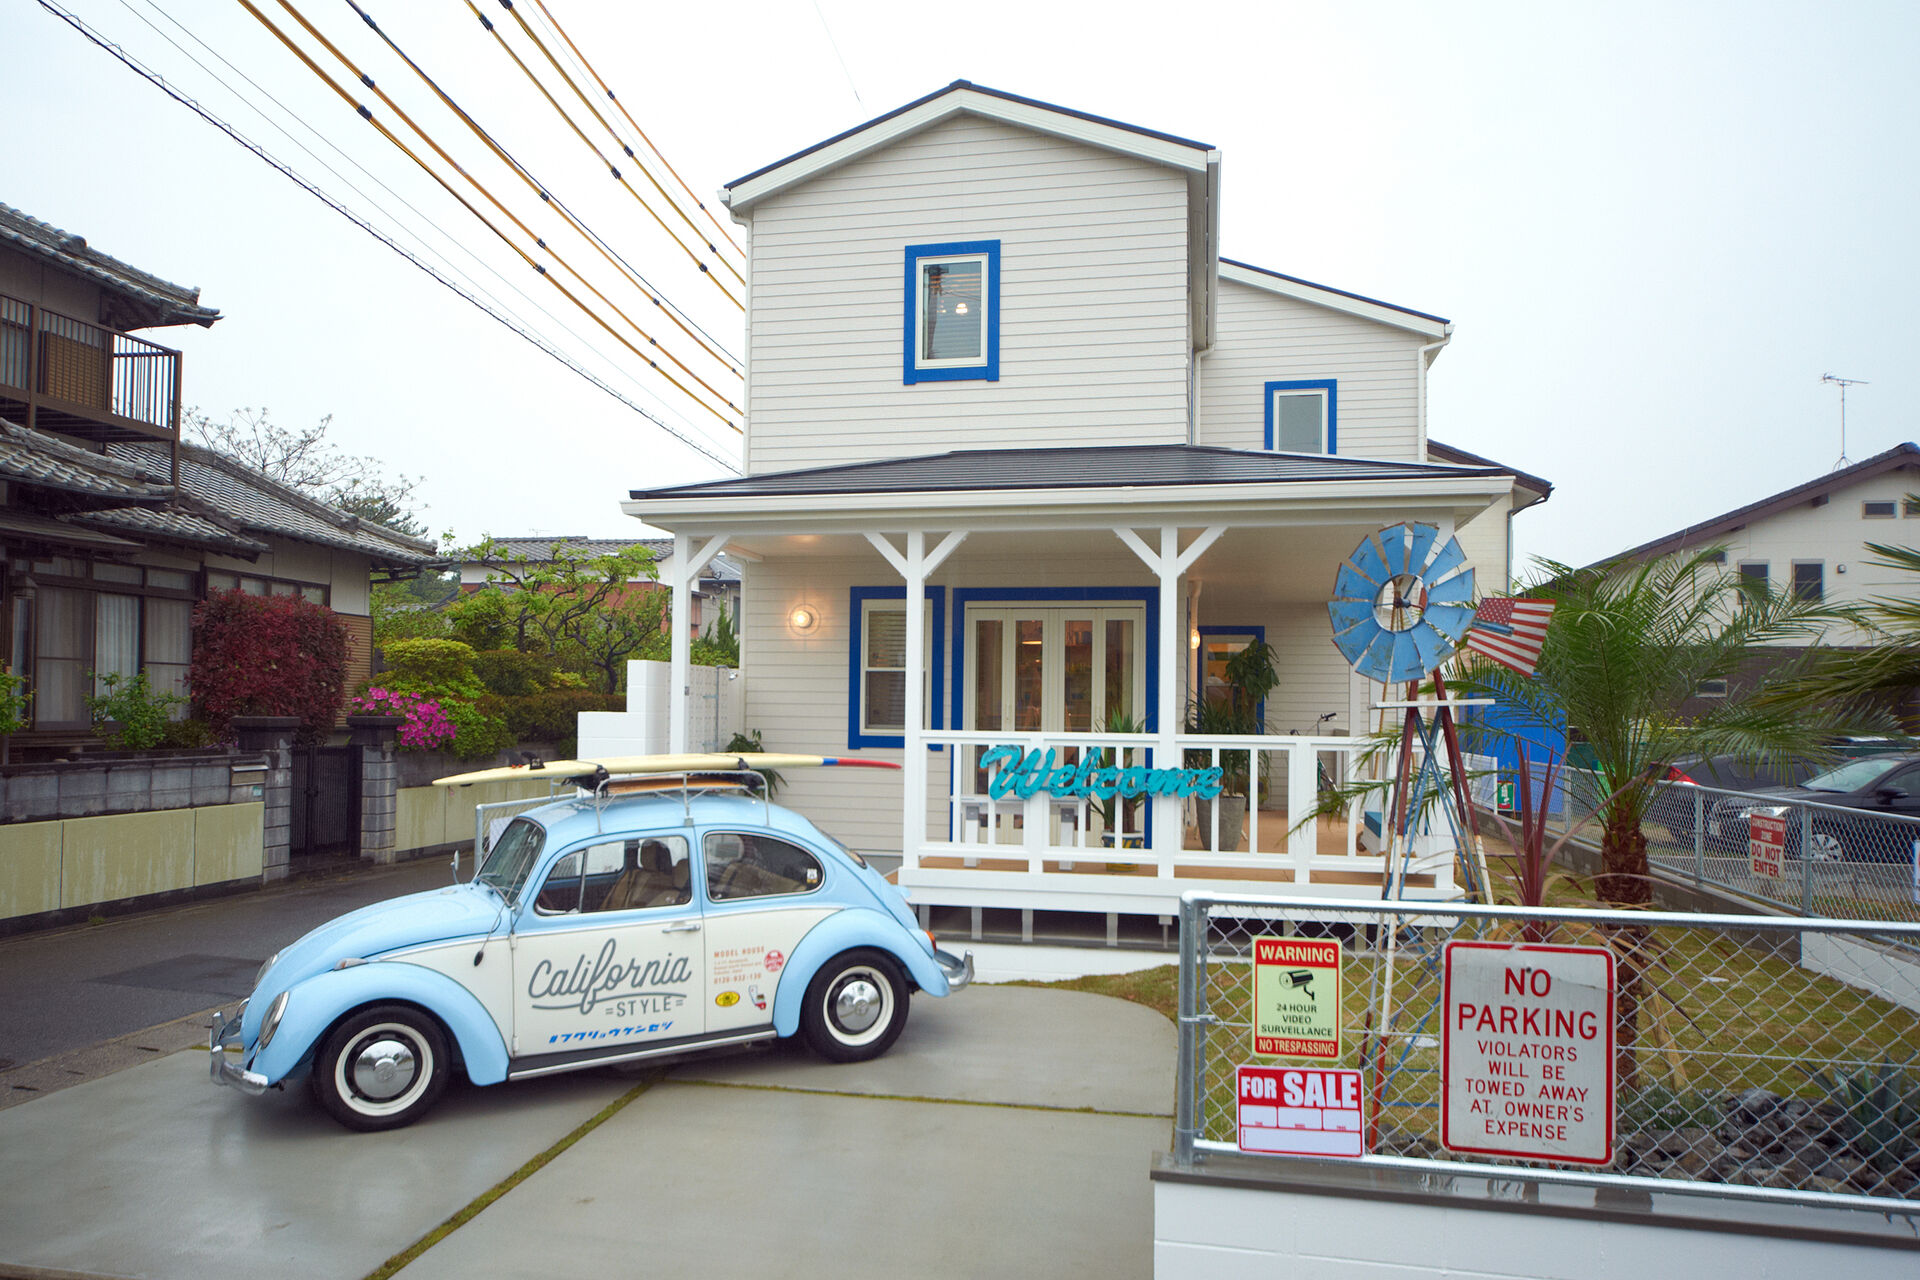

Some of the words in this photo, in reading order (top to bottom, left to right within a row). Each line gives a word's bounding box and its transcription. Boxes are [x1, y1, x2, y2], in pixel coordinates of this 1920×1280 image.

[980, 744, 1224, 801] Welcome
[1751, 843, 1761, 857] DO
[1765, 847, 1781, 863] NOT
[1754, 859, 1779, 878] ENTER
[1260, 945, 1335, 963] WARNING
[528, 938, 692, 1016] California
[1505, 967, 1551, 997] NO
[1277, 1003, 1287, 1012] 24
[1289, 1004, 1317, 1014] HOUR
[1282, 1014, 1312, 1024] VIDEO
[1261, 1024, 1333, 1037] SURVEILLANCE
[1458, 1003, 1597, 1040] PARKING
[1259, 1039, 1272, 1052] NO
[1273, 1040, 1335, 1056] TRESPASSING
[1477, 1040, 1577, 1062] VIOLATORS
[1488, 1061, 1529, 1078] WILL
[1543, 1064, 1565, 1081] BE
[1241, 1076, 1277, 1099] FOR
[1283, 1072, 1358, 1109] SALE
[1465, 1078, 1525, 1097] TOWED
[1538, 1084, 1589, 1103] AWAY
[1470, 1099, 1491, 1114] AT
[1505, 1101, 1584, 1122] OWNER'S
[1485, 1120, 1567, 1141] EXPENSE
